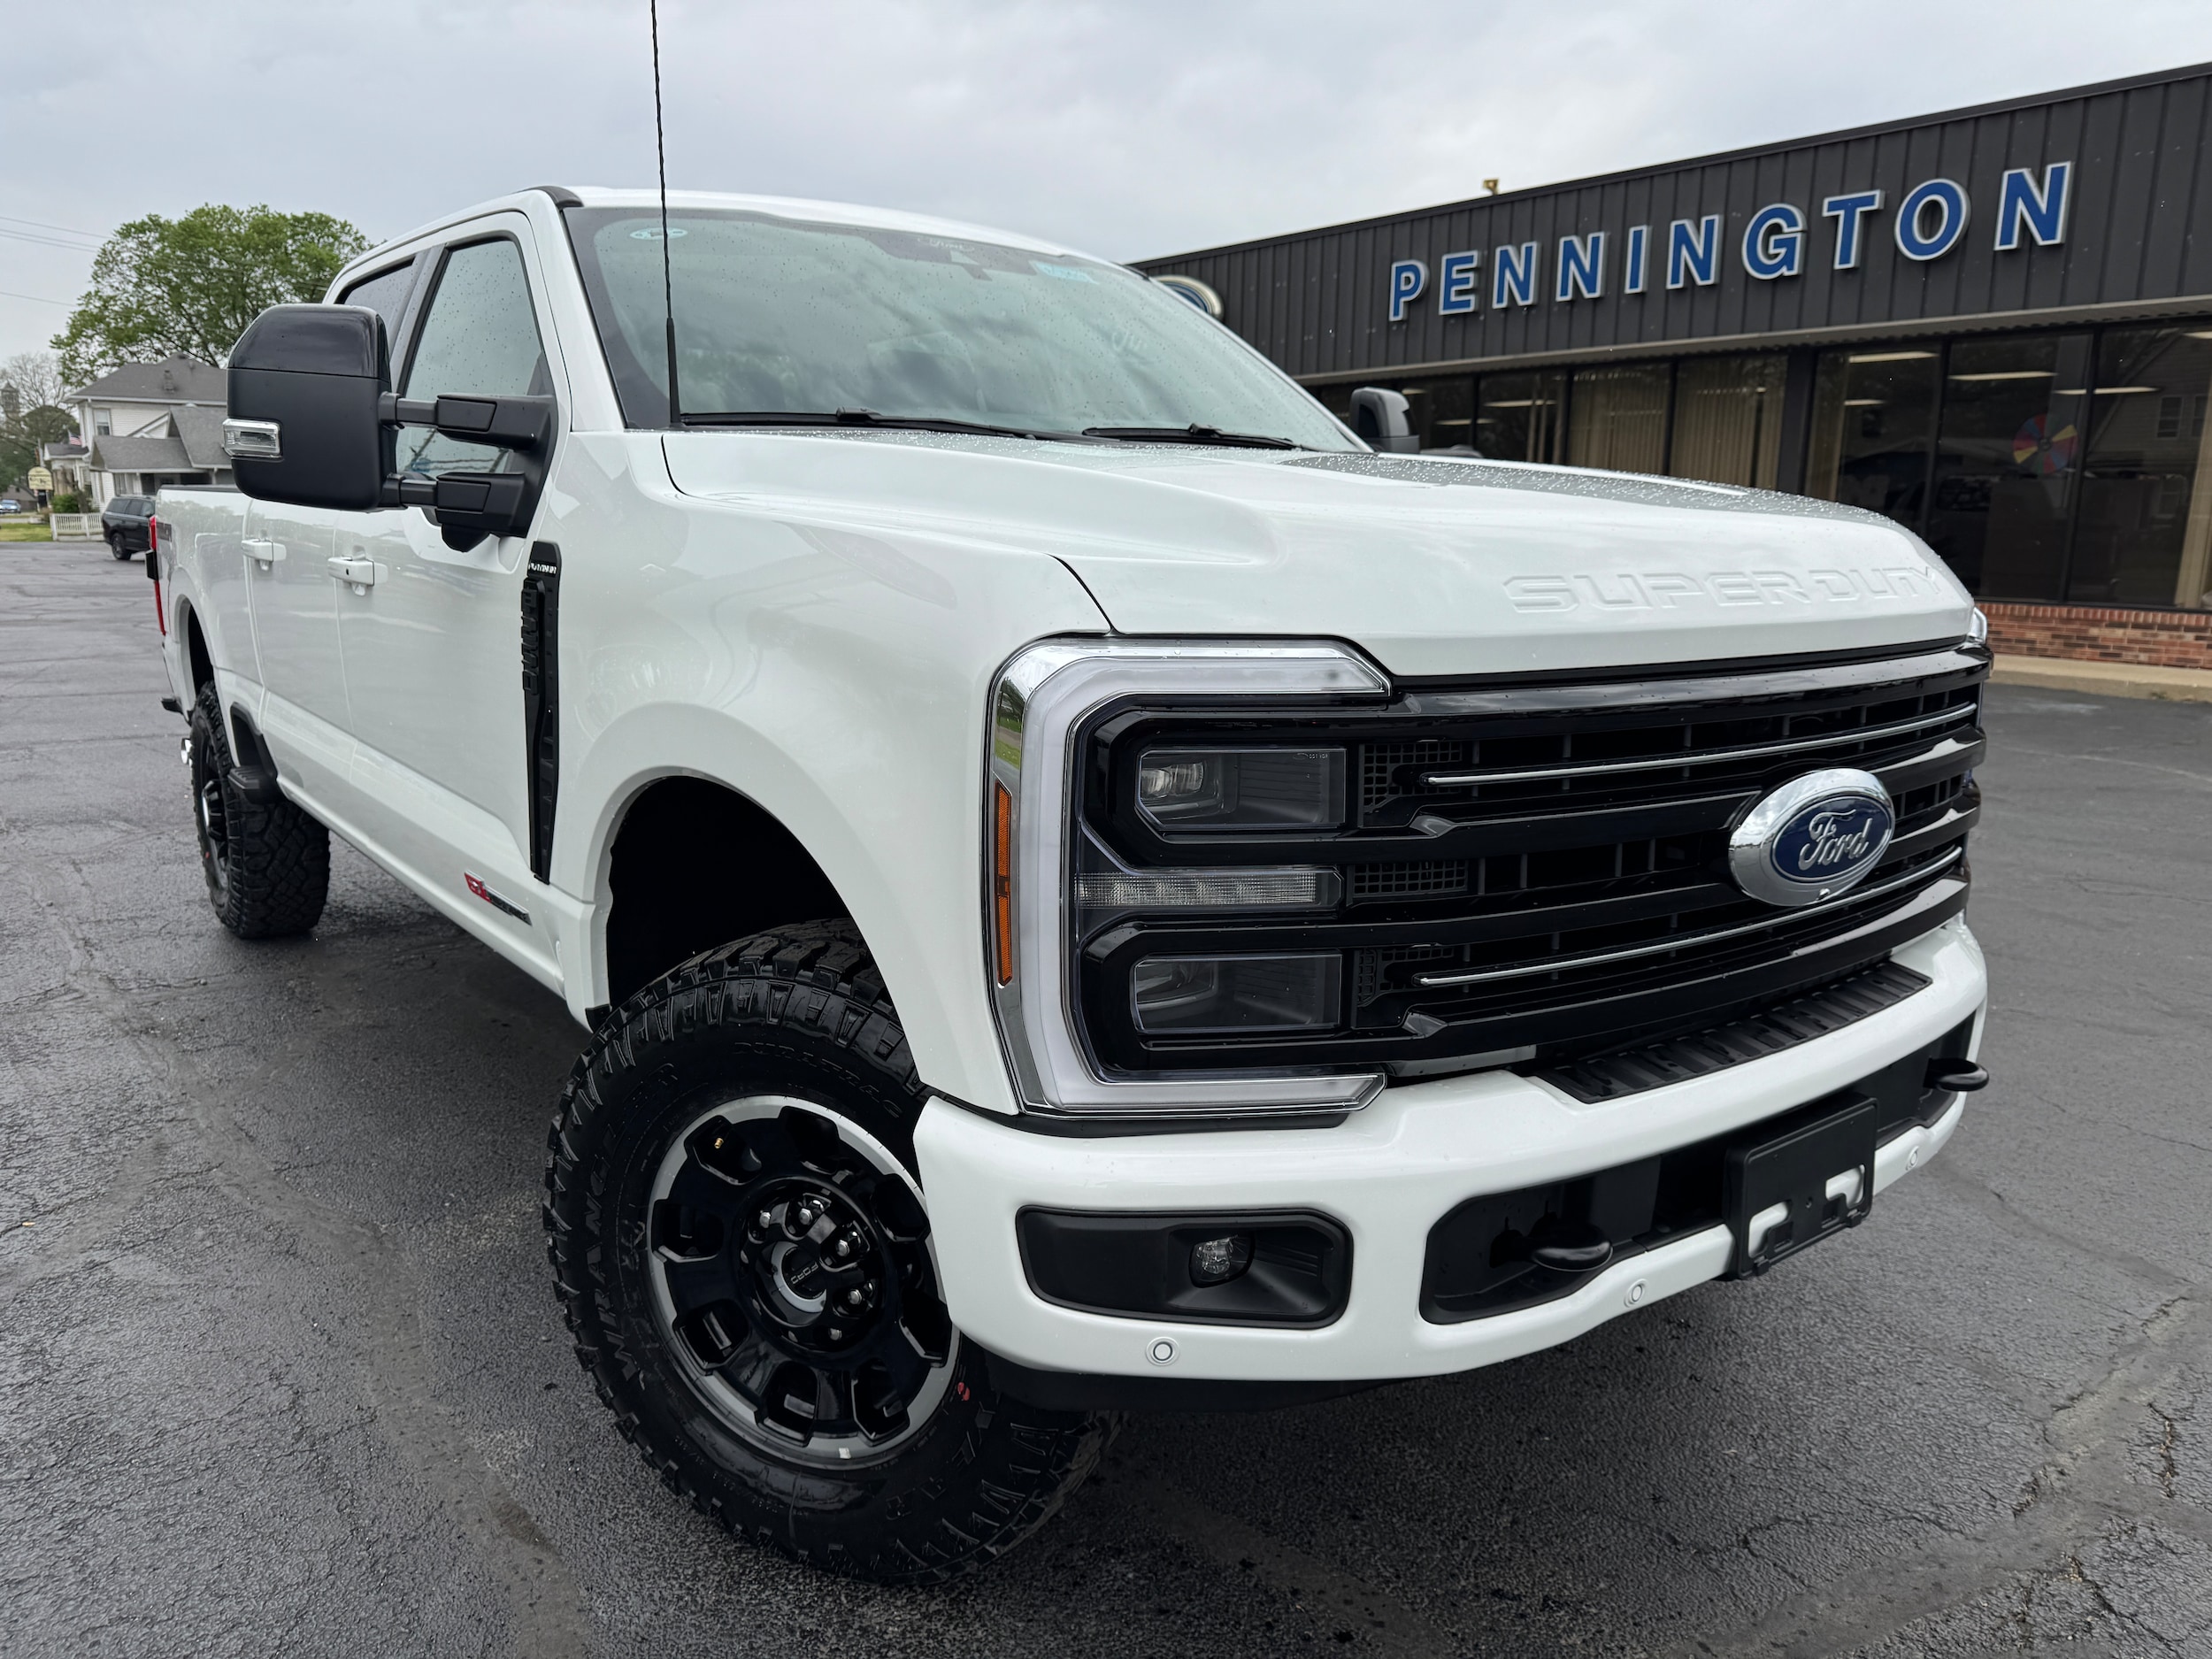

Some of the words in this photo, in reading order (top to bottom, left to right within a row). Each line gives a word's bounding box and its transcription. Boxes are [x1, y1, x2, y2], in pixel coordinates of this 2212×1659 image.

[1389, 161, 2071, 320] PENNINGTON
[1503, 571, 1811, 613] SUPER
[1809, 567, 1942, 603] DUTY
[1798, 809, 1873, 871] Ford
[731, 1041, 905, 1120] DURATRAC
[789, 1260, 820, 1286] FORD
